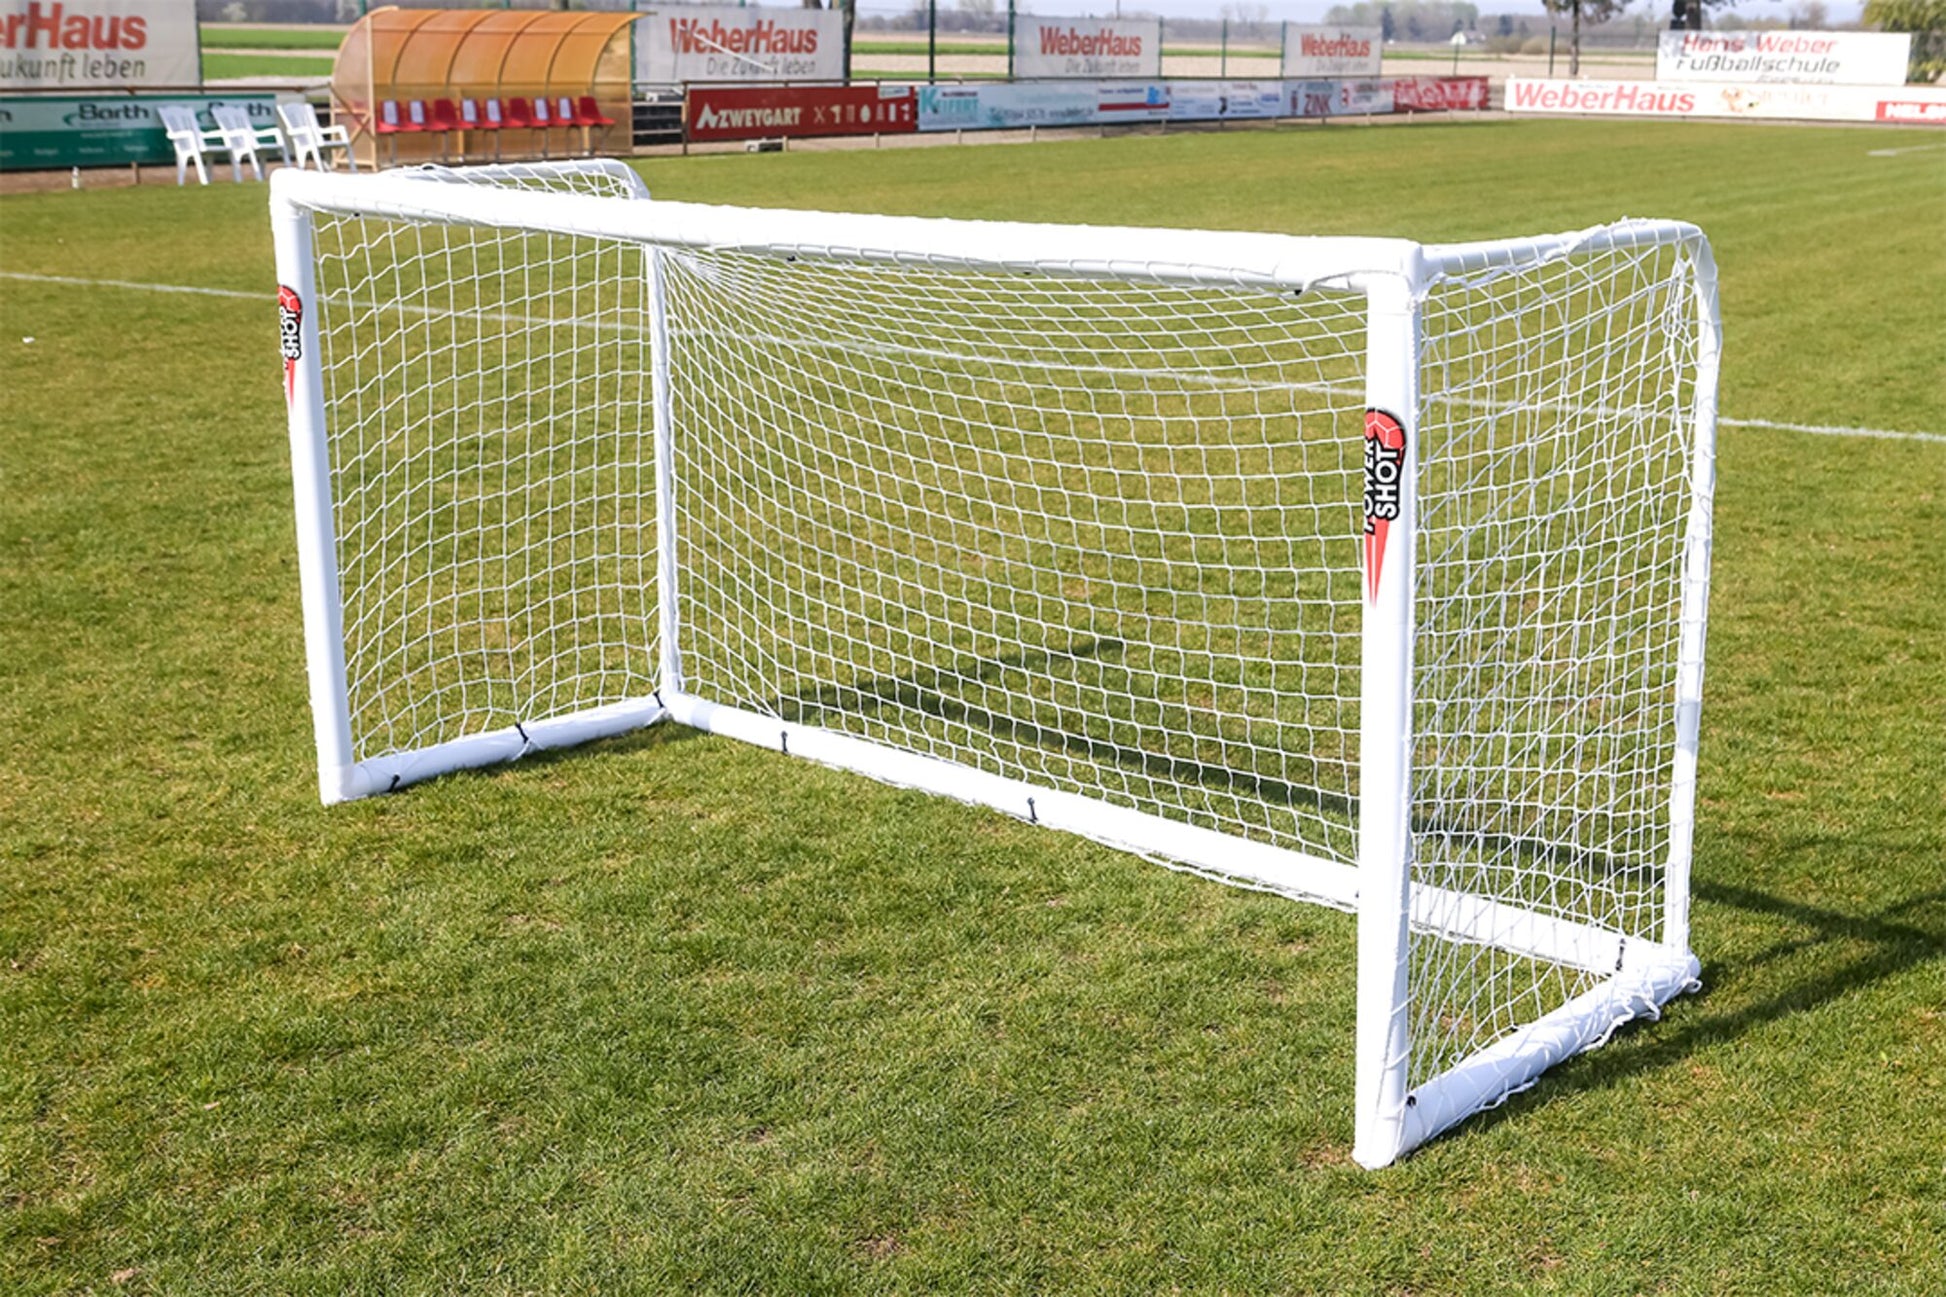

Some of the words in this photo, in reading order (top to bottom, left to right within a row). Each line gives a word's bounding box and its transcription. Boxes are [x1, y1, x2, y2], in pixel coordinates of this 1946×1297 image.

[669, 18, 818, 54] WeberHaus
[1040, 26, 1142, 56] WeberHaus
[1301, 33, 1371, 57] WeberHaus
[1681, 32, 1745, 53] Hans
[1756, 34, 1837, 53] Weber
[82, 52, 146, 78] leben
[706, 57, 728, 75] Die
[782, 58, 816, 75] leben
[1676, 54, 1841, 73] Fußballschule
[1515, 82, 1695, 112] WeberHaus
[78, 103, 149, 120] Barth
[718, 107, 801, 129] ZWEYGART
[280, 306, 299, 359] SHOT
[1374, 438, 1398, 519] SHOT
